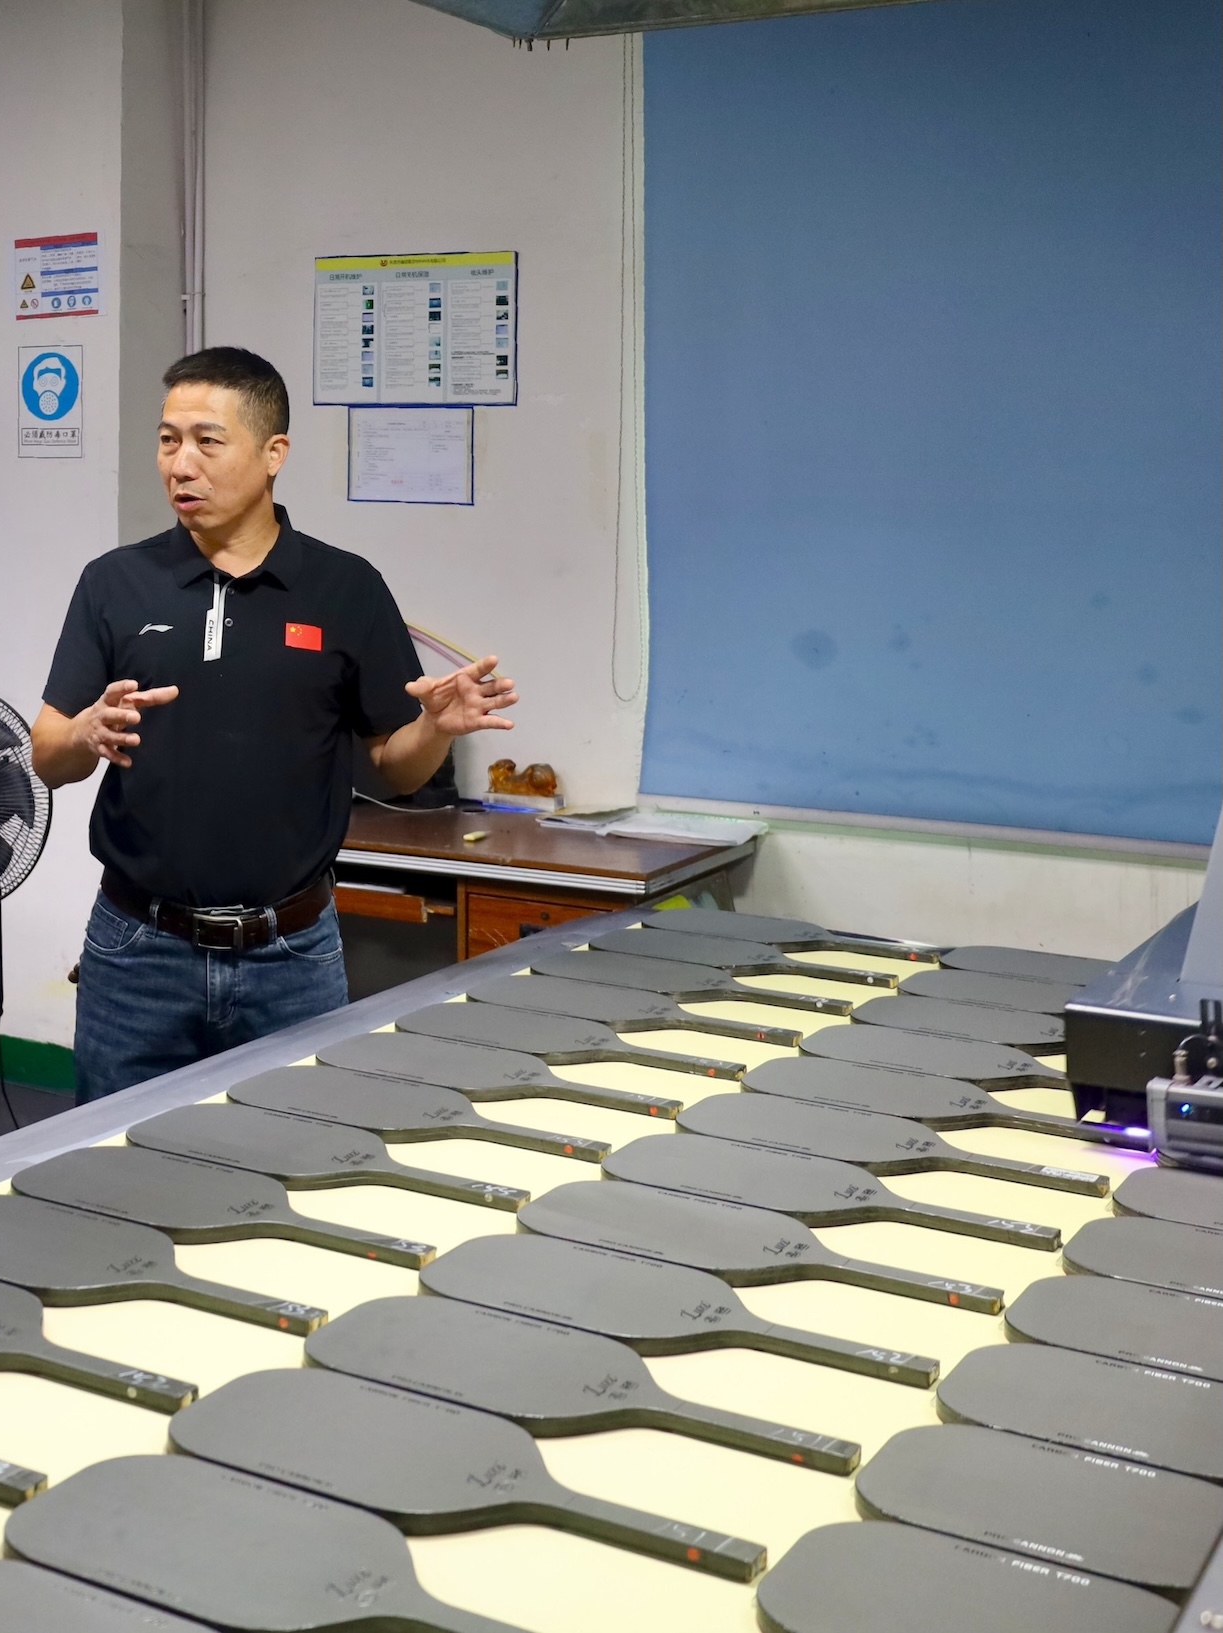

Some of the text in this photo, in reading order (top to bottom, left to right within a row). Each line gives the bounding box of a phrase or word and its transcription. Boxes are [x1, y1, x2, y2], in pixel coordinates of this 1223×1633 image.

[24, 430, 77, 439] 必须戴防毒口罩
[206, 619, 215, 652] CHINA
[1144, 1370, 1177, 1382] FIBER
[1181, 1378, 1212, 1389] T700
[1084, 1456, 1120, 1470] FIBER
[1124, 1465, 1158, 1478] T700
[1012, 1559, 1050, 1576] FIBER
[1056, 1571, 1092, 1588] T700
